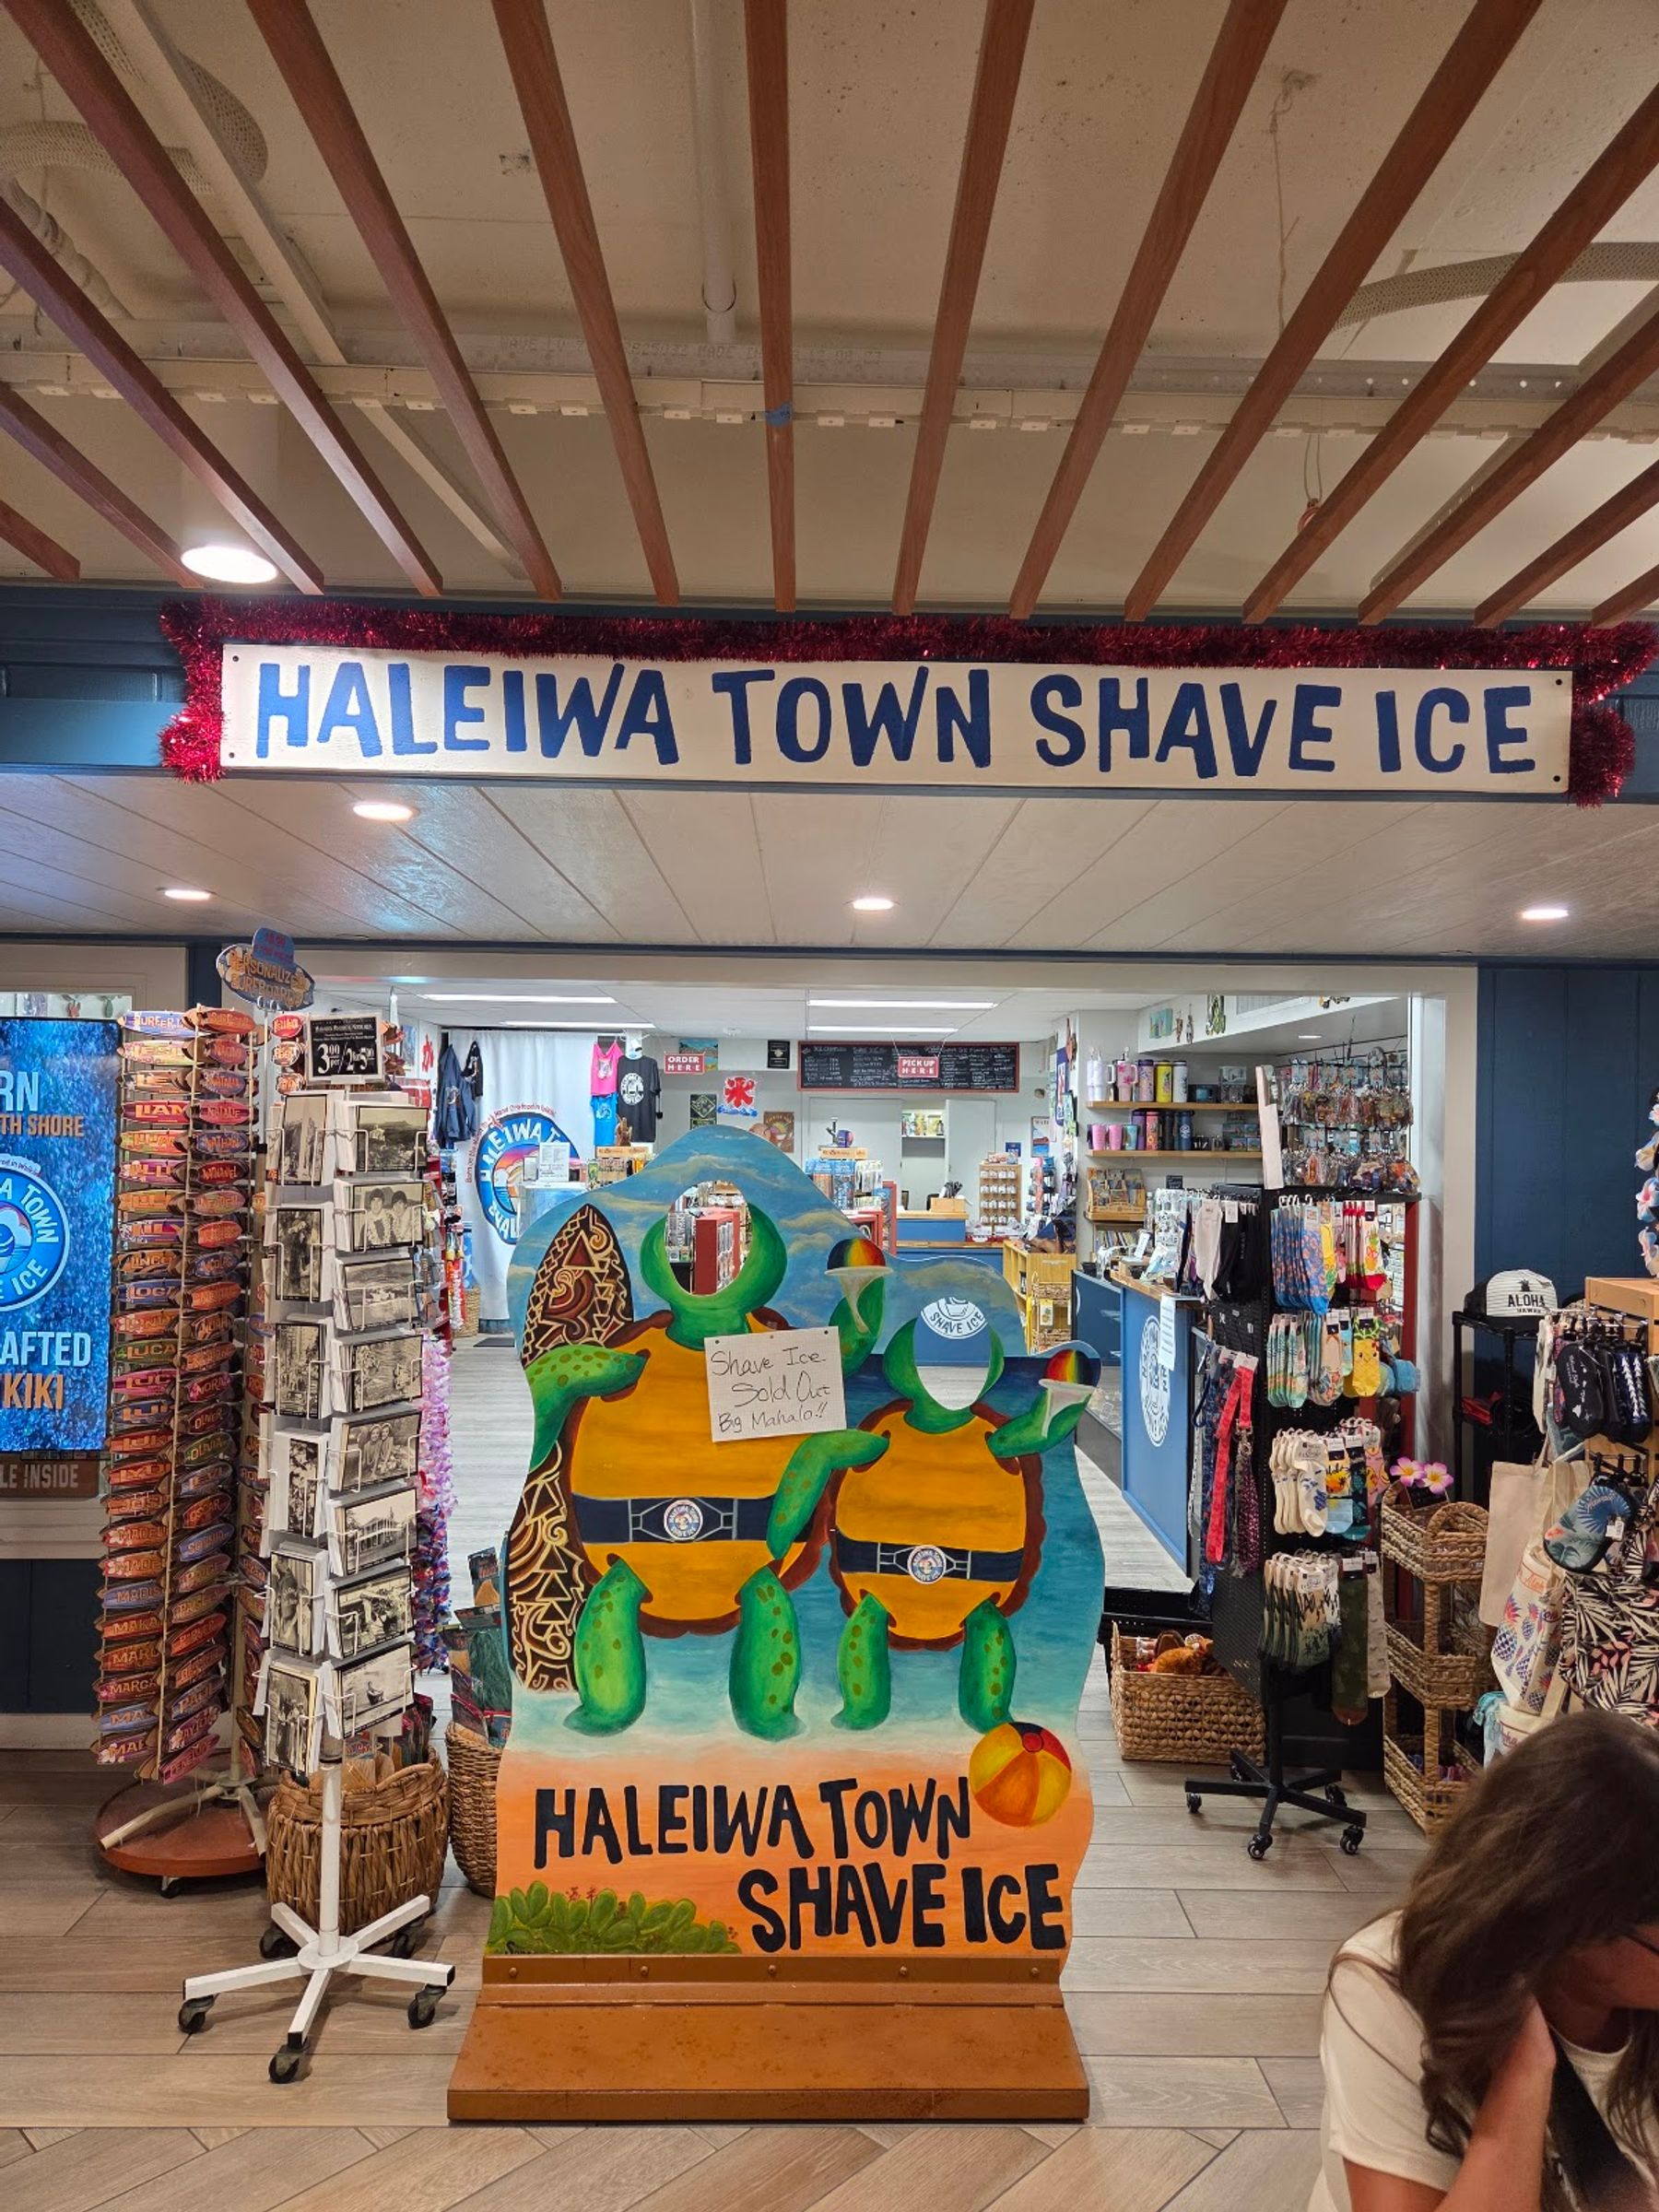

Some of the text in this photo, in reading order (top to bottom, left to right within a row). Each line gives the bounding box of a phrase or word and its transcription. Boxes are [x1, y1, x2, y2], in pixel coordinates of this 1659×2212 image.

[256, 663, 1535, 780] HALEIWA TOWN SHAVE ICE
[667, 1055, 700, 1064] ORDER
[28, 1114, 84, 1137] SHORE
[20, 1183, 59, 1243] TOWN
[11, 1259, 49, 1295] ICE
[1508, 1294, 1546, 1308] ALOHA
[930, 1312, 984, 1334] SHAVE ICE
[1, 1331, 91, 1367] AFTED
[711, 1346, 826, 1377] Shave Ice
[731, 1370, 831, 1407] Sold Out
[718, 1412, 743, 1433] Big
[24, 1464, 79, 1488] INSIDE
[535, 1777, 971, 1869] HALEIWA TOWN
[737, 1862, 1067, 1953] SHAVE ICE
